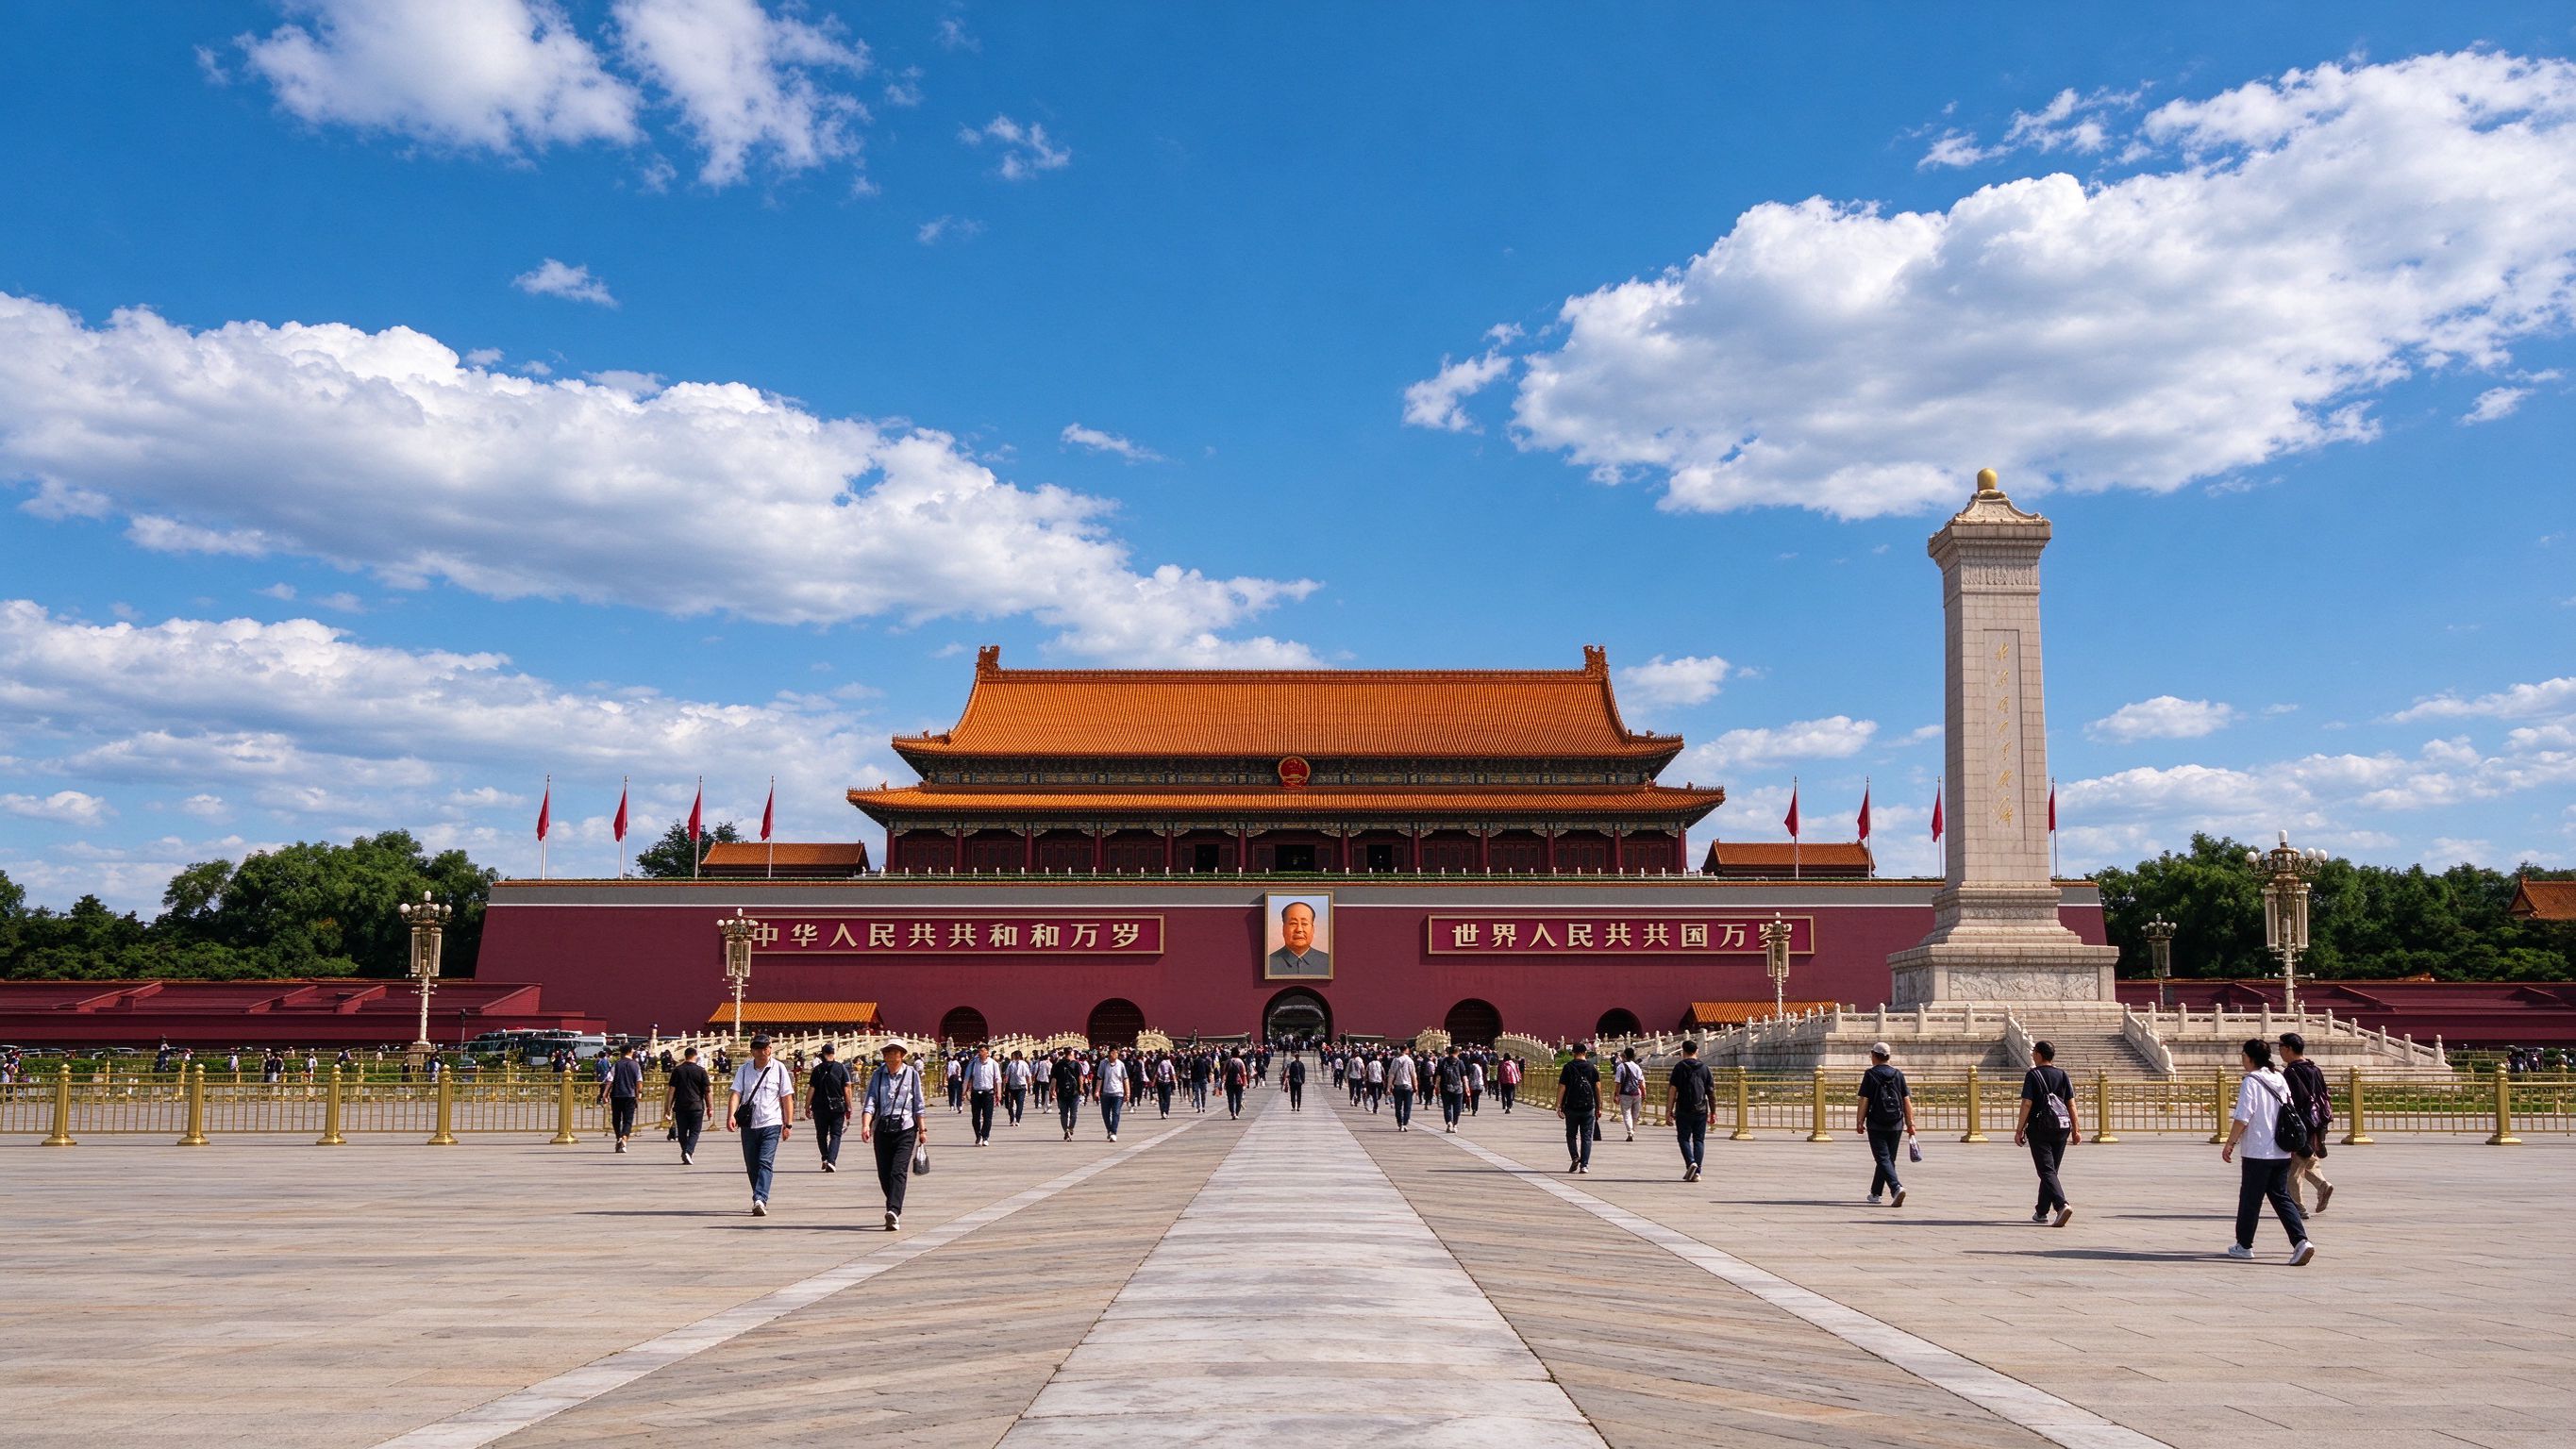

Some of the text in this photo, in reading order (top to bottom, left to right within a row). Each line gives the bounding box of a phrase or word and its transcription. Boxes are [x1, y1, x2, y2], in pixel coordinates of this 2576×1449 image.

[753, 922, 1140, 948] 中华人民共共和和万岁
